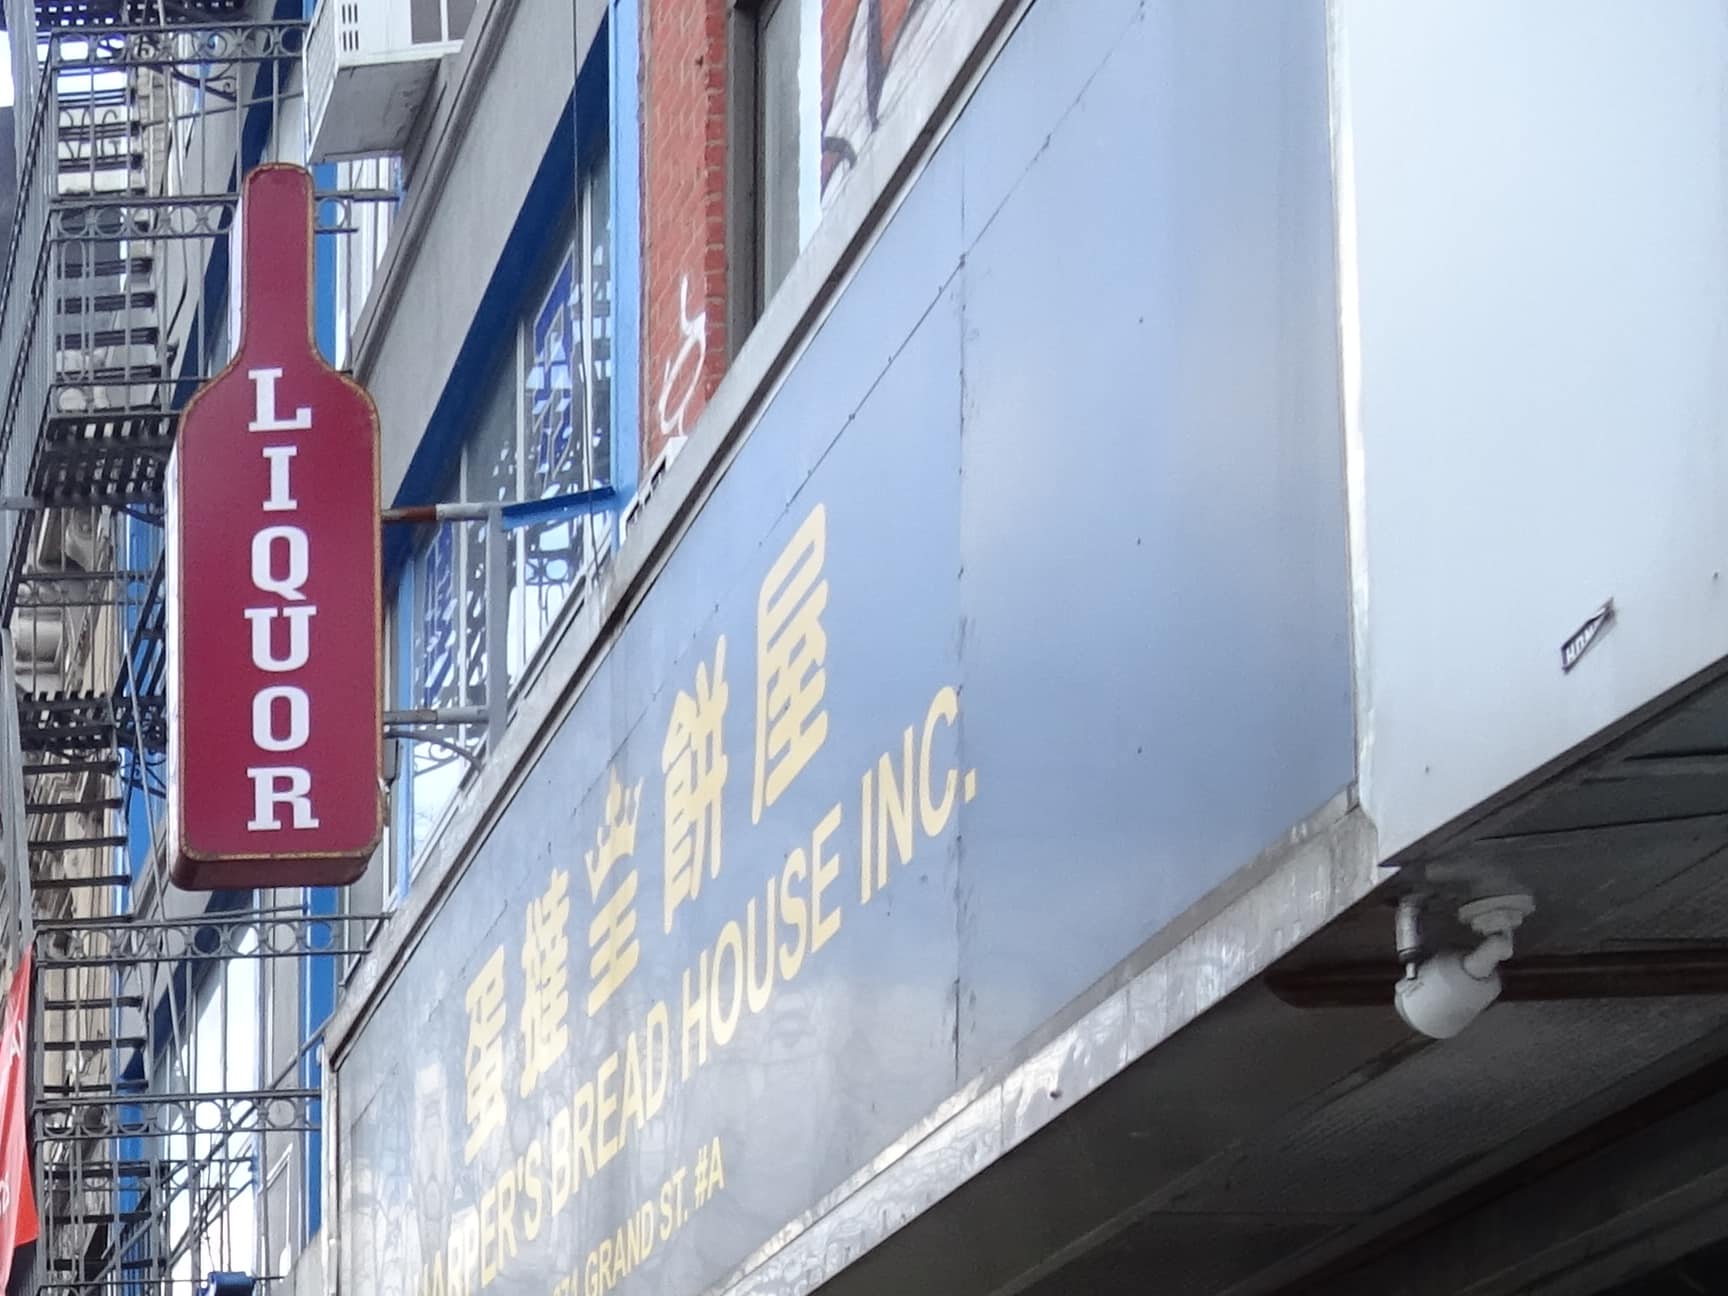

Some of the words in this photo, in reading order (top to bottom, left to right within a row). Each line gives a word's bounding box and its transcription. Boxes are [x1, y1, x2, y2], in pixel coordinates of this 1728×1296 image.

[244, 367, 319, 832] LIQUOR
[547, 1008, 670, 1218] BREAD
[681, 804, 843, 1082] HOUSE
[859, 685, 978, 906] INC.
[659, 1165, 689, 1241] ST.
[694, 1136, 726, 1210] #A
